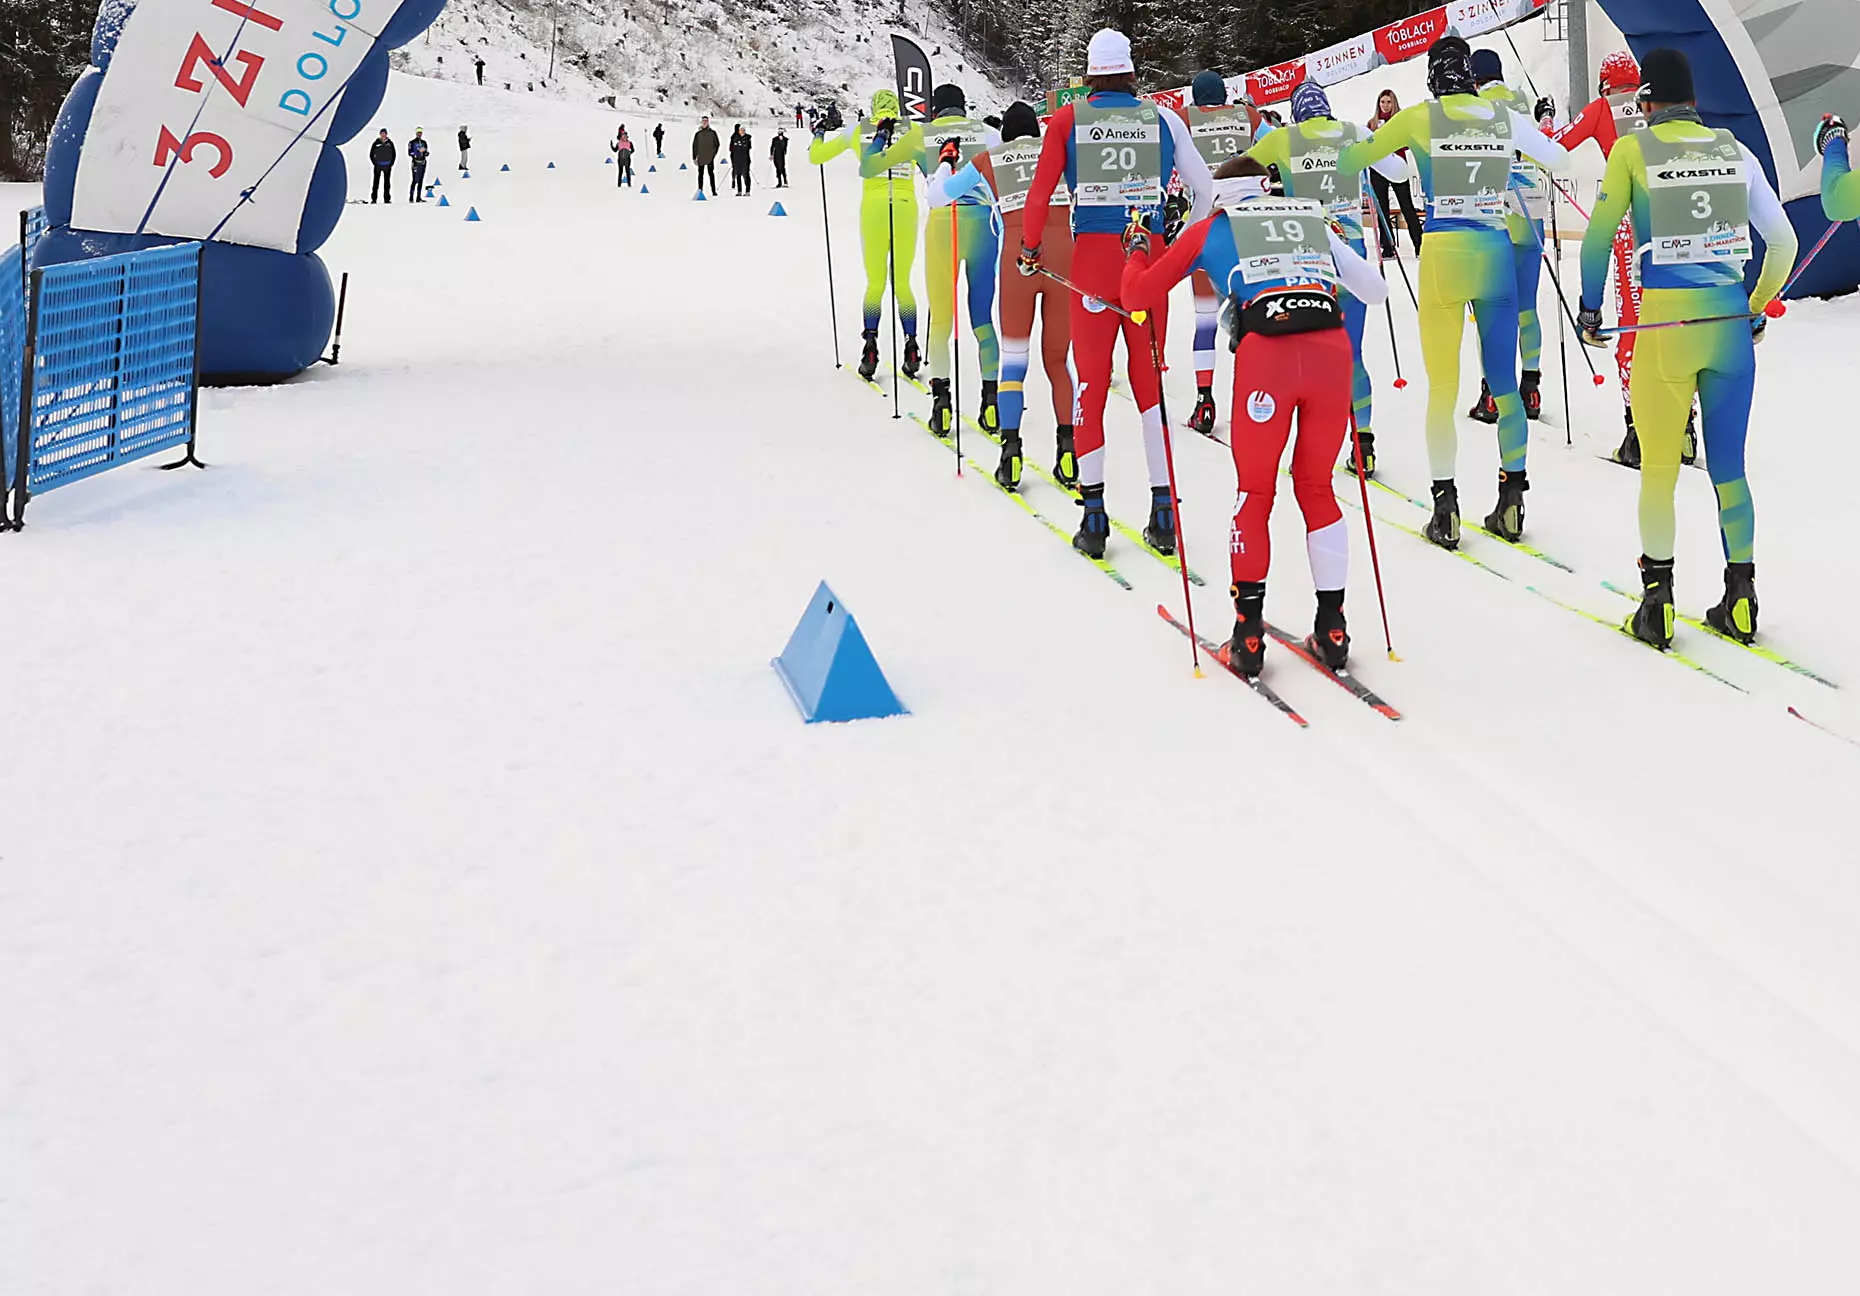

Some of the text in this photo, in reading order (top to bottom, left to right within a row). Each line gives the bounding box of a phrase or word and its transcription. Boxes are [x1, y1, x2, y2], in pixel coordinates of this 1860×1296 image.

[1457, 8, 1467, 21] 3
[1386, 19, 1435, 46] TOBLACH
[1316, 44, 1366, 72] 3 ZINNEN
[903, 66, 926, 120] CM
[1105, 127, 1147, 140] Anexis
[152, 123, 235, 180] 3
[1210, 136, 1238, 154] 13
[1016, 151, 1040, 162] Anex
[1100, 147, 1137, 171] 20
[1315, 158, 1336, 169] Ane
[1465, 161, 1482, 184] 7
[1319, 174, 1336, 194] 4
[1690, 190, 1712, 219] 3
[1260, 219, 1305, 243] 19
[1661, 239, 1692, 249] CMP
[1285, 298, 1333, 313] COXA
